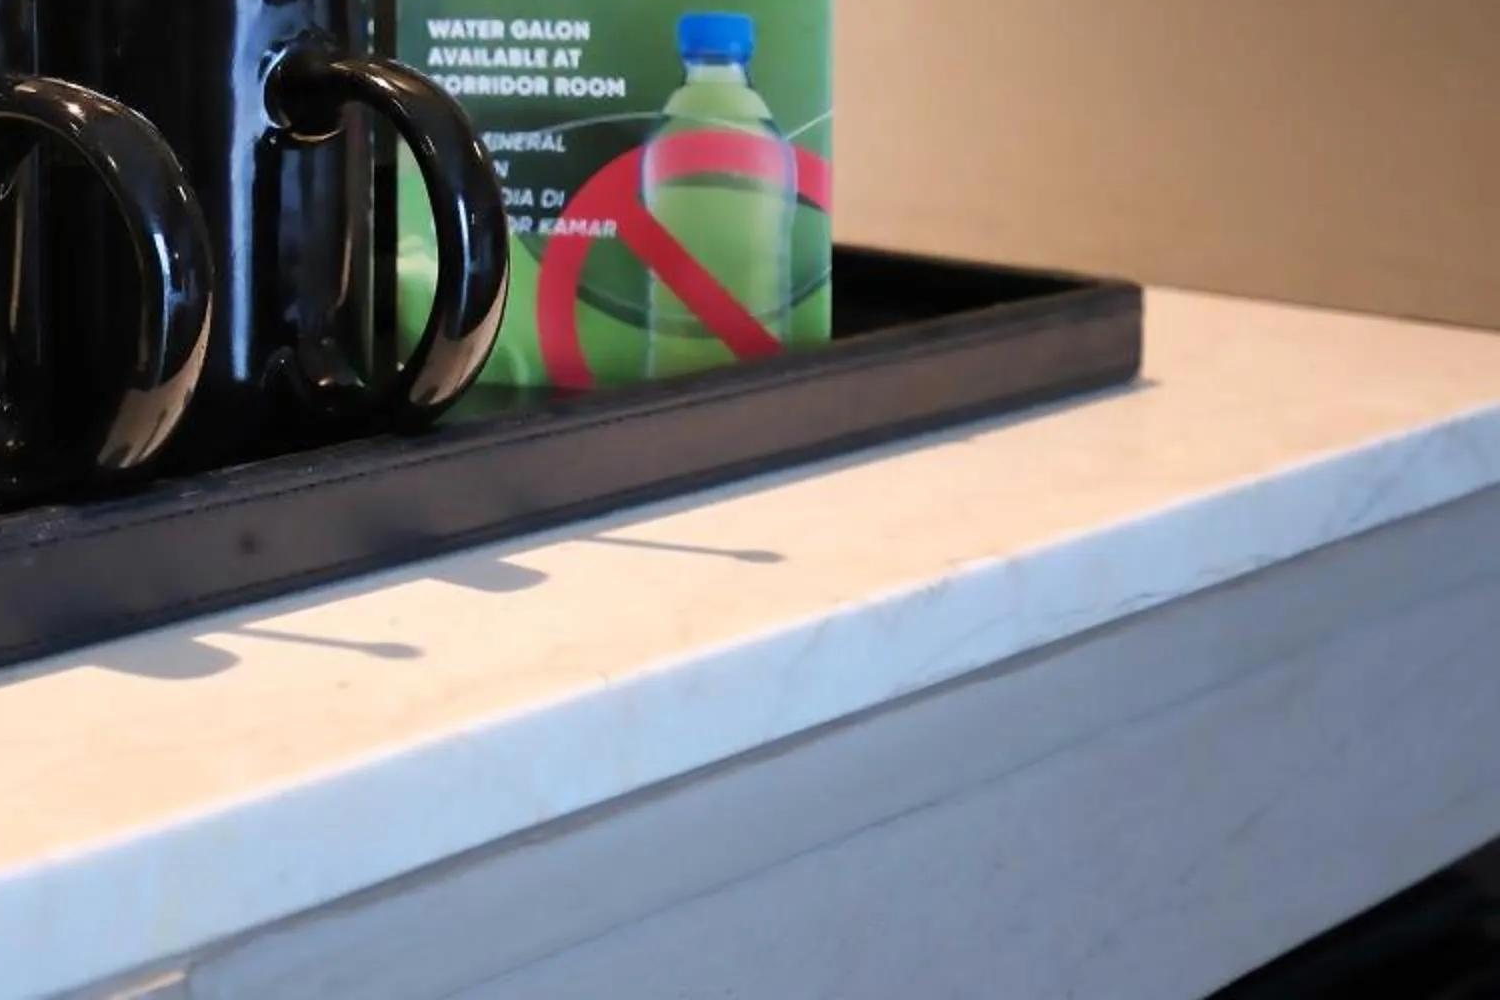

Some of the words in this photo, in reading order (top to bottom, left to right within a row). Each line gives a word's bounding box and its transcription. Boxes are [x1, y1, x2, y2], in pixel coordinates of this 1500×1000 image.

[427, 19, 505, 39] WATER
[510, 20, 591, 40] GALON
[427, 47, 548, 67] AVAILABLE
[553, 48, 582, 68] AT
[554, 76, 626, 97] ROOM
[538, 215, 617, 239] KAMAR
